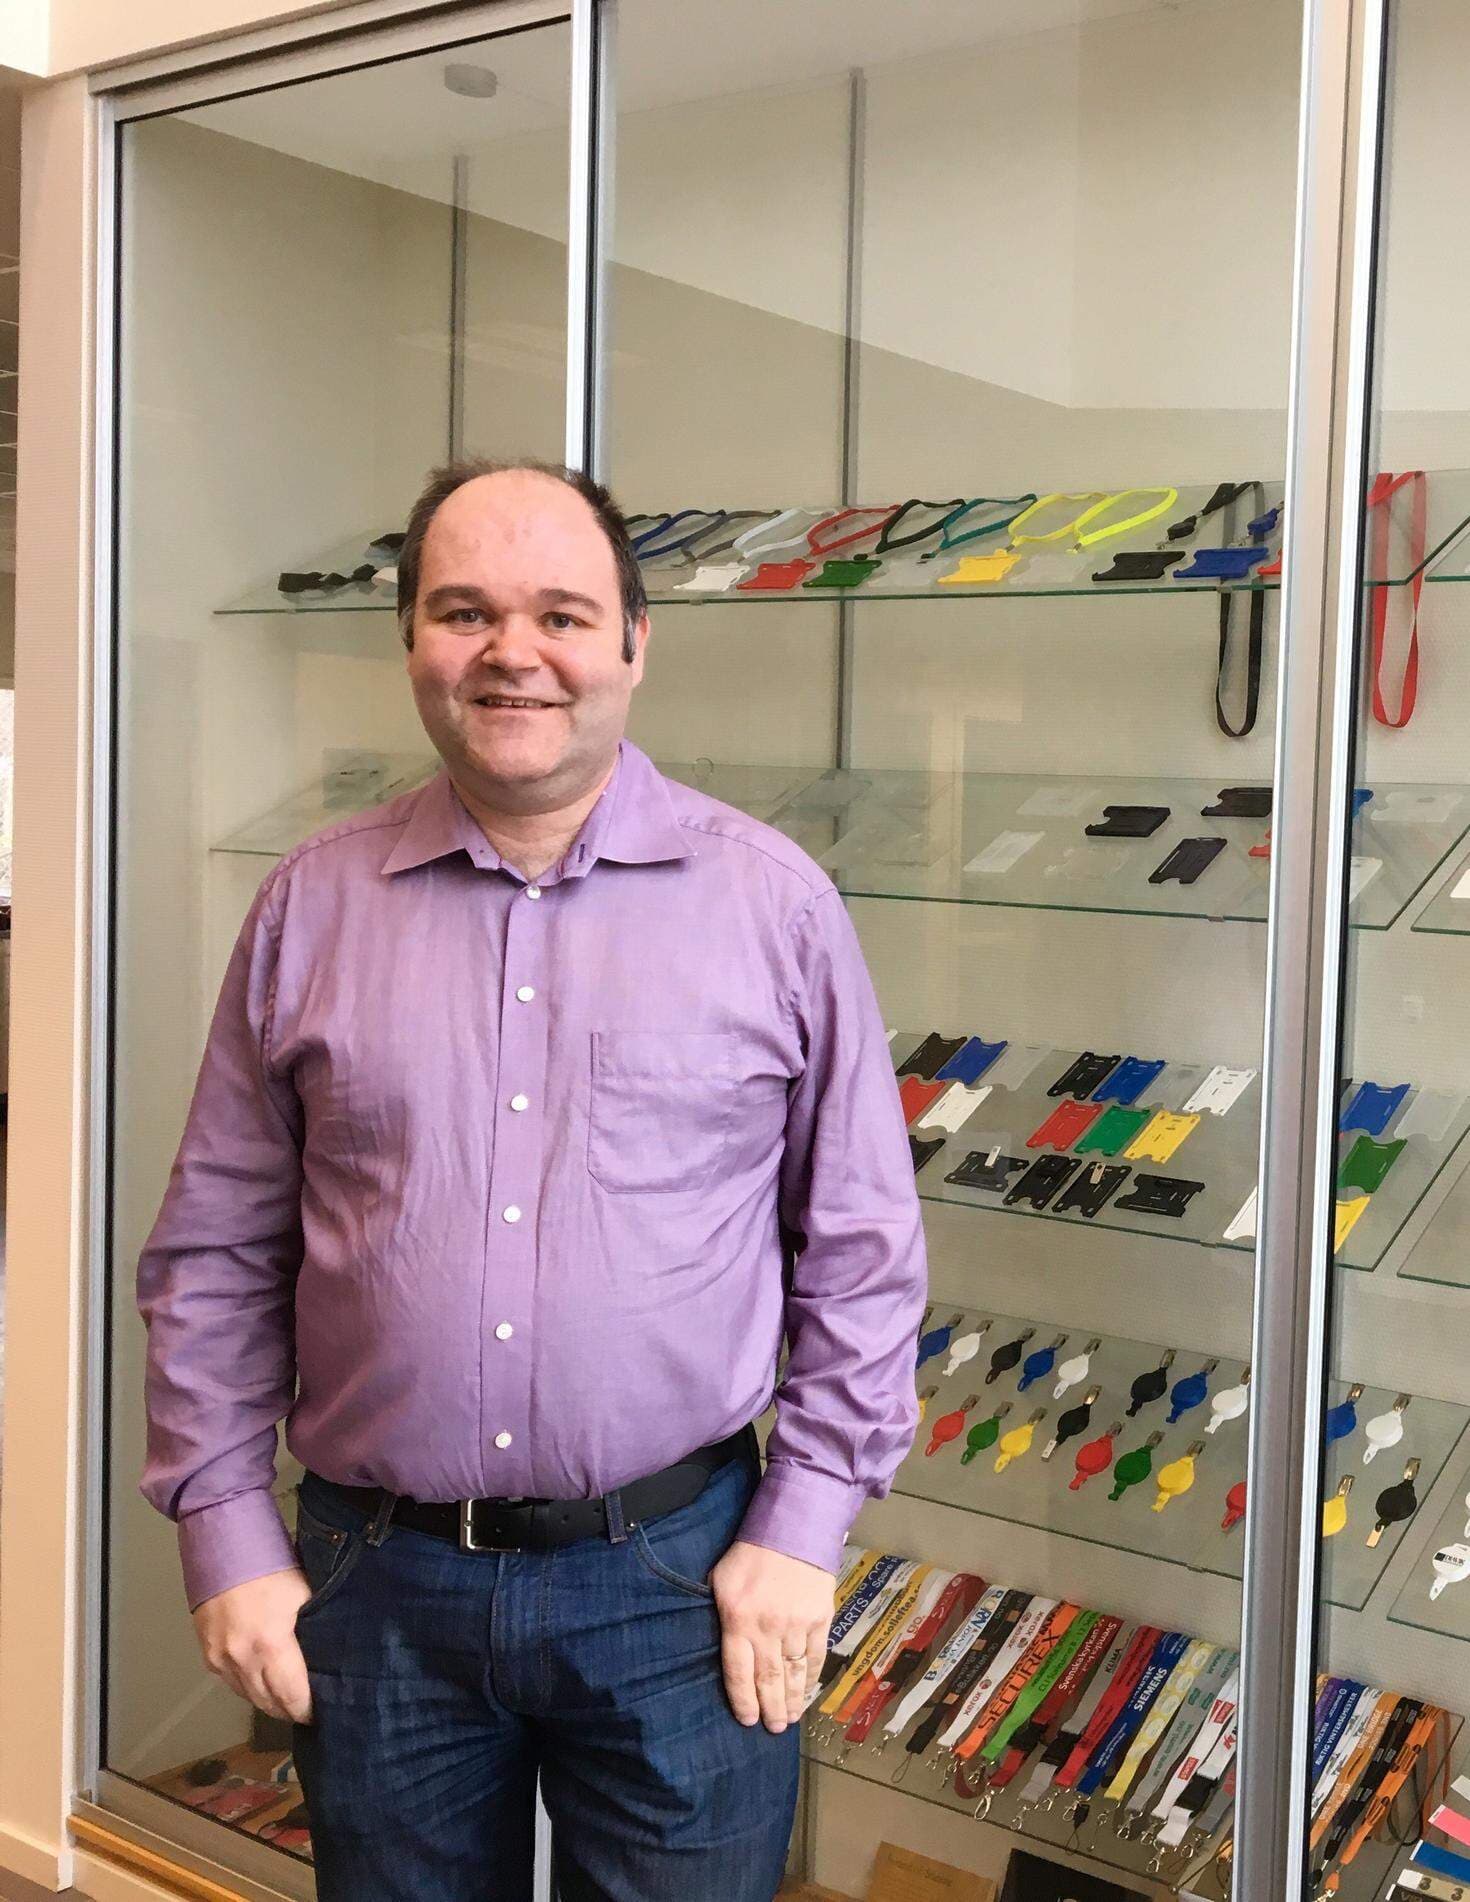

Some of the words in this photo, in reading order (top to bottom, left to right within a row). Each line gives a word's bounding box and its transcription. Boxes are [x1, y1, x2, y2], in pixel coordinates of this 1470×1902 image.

[833, 1594, 869, 1638] PARTS
[1105, 1648, 1121, 1674] KLIMA
[978, 1629, 1061, 1729] SECUREX
[1134, 1668, 1168, 1712] SIEMENS
[963, 1692, 983, 1717] xerox
[1315, 1744, 1330, 1766] RIKTIG
